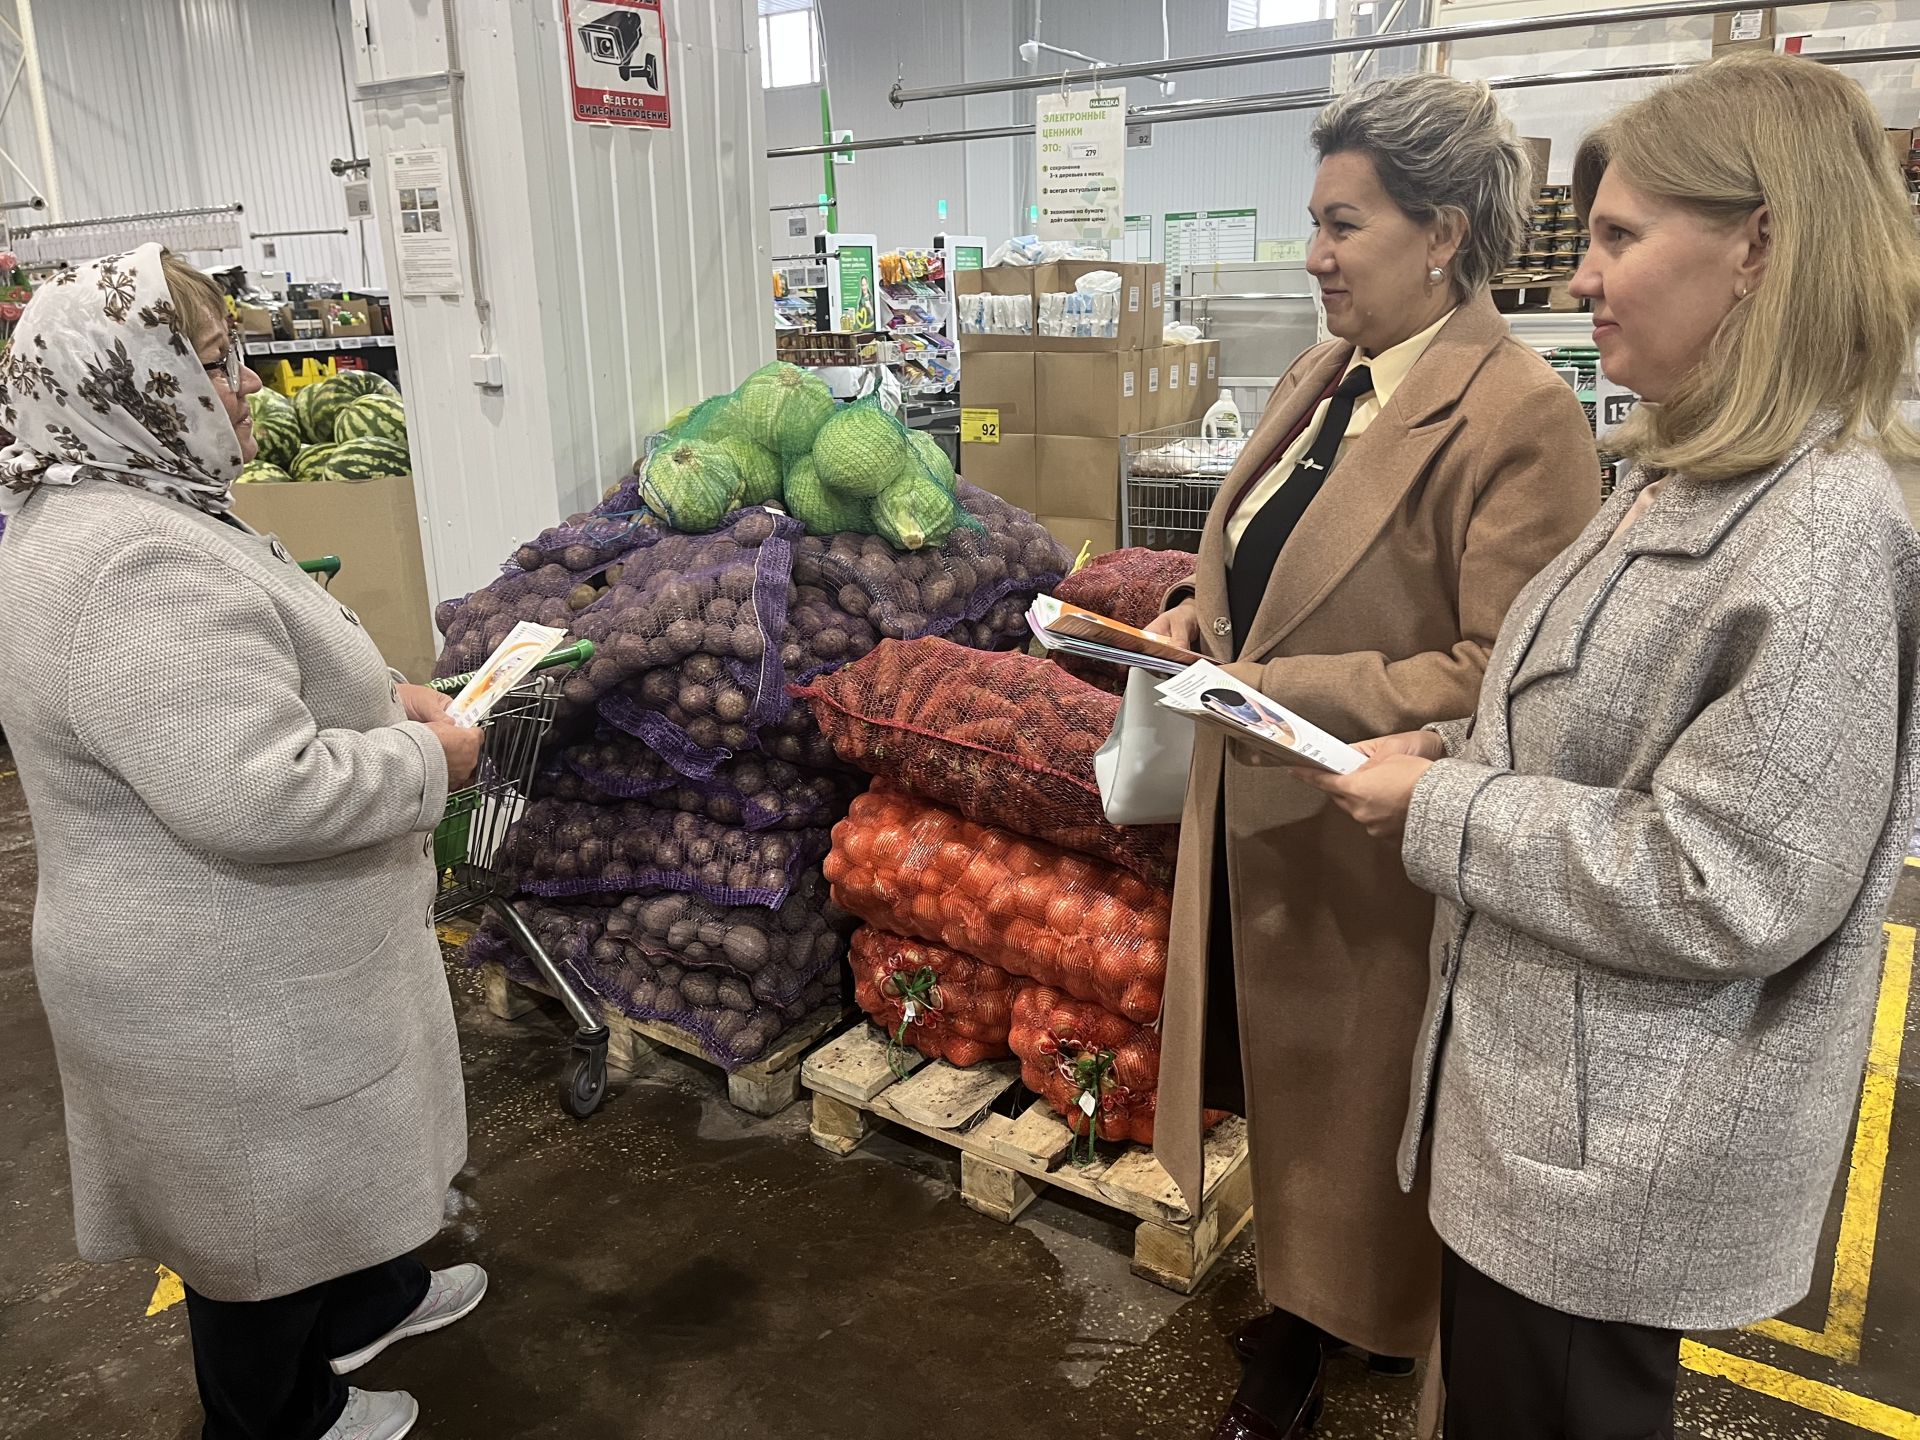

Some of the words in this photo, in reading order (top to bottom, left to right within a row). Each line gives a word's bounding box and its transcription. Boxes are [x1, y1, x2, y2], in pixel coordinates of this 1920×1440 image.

[603, 95, 644, 106] ВЕДЕТСЯ
[1090, 99, 1119, 107] НАХОДКА
[580, 105, 668, 121] ВИДЕОНАБЛЮДЕНИЕ
[1043, 110, 1106, 122] ЭЛЕКТРОННЫЕ
[1043, 128, 1083, 138] ЦЕННИКИ
[1138, 135, 1149, 144] 92
[1042, 143, 1062, 152] ЭТО:
[1085, 149, 1097, 157] 279
[982, 424, 996, 436] 92
